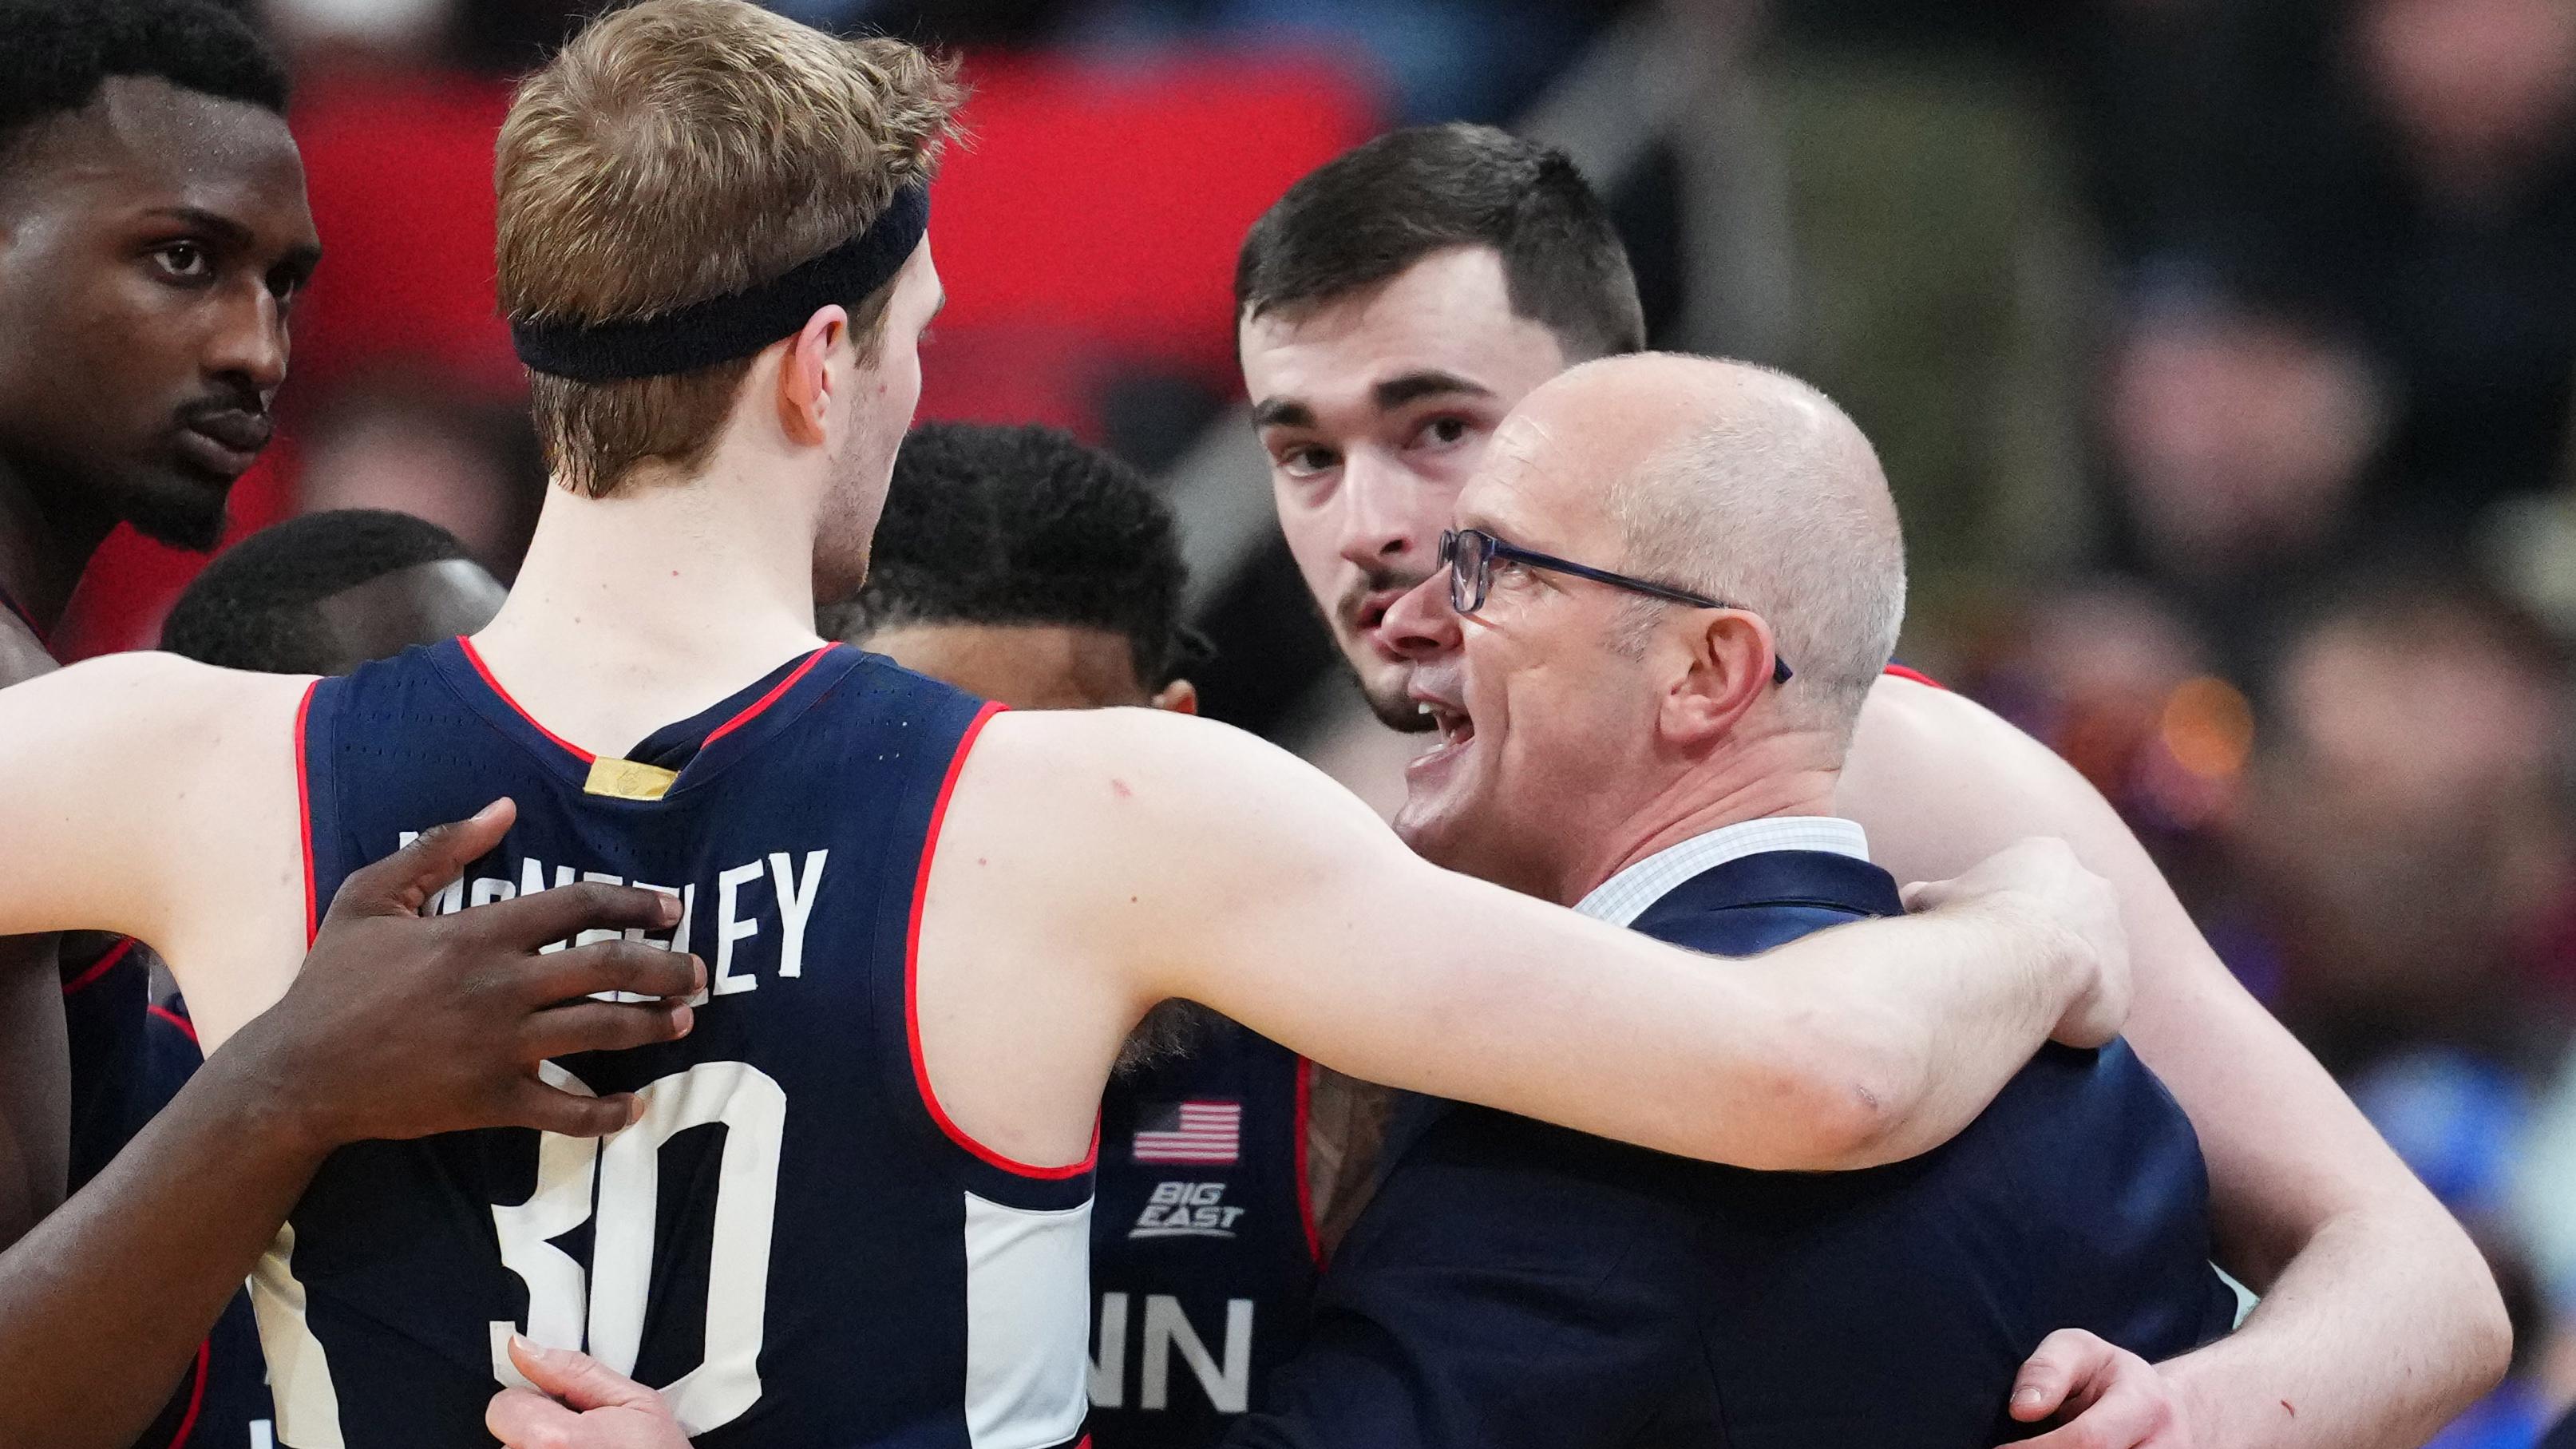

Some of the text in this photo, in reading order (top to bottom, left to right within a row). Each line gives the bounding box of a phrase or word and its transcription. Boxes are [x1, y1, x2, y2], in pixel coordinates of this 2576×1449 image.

[1150, 1181, 1226, 1206] BIG
[1136, 1206, 1245, 1228] EAST
[489, 1060, 787, 1437] 30
